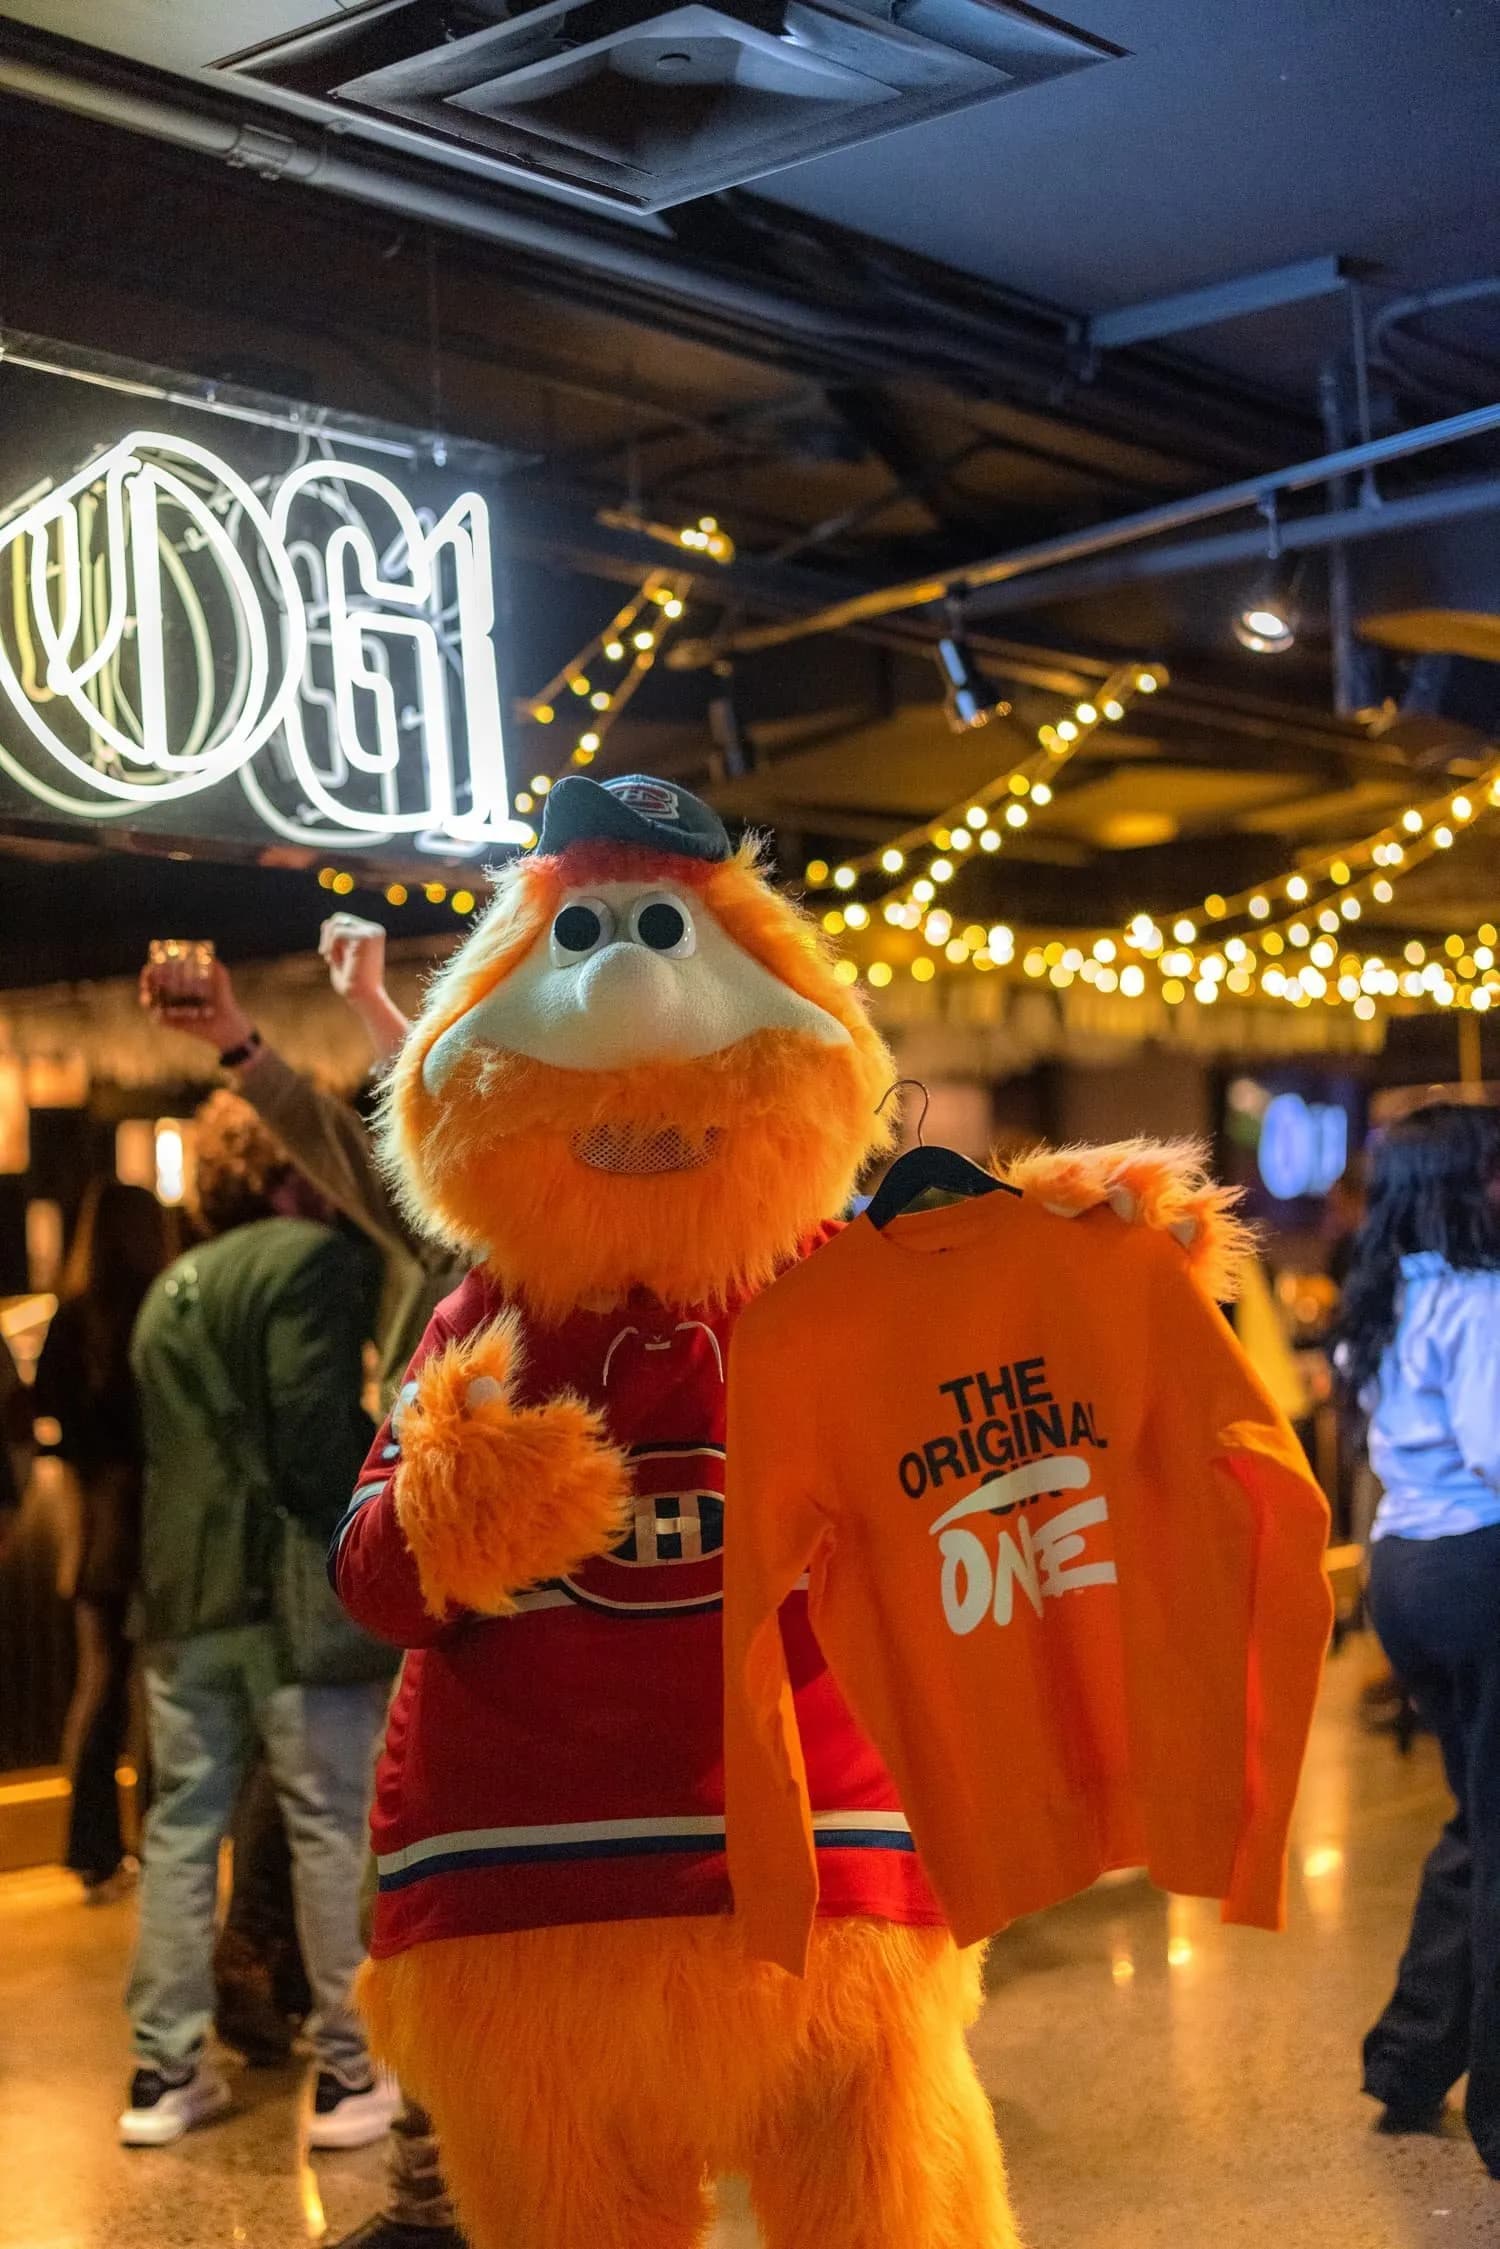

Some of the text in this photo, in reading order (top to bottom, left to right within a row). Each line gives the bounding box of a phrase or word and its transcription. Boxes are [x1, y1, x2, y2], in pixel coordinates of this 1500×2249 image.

[939, 1356, 1053, 1424] THE
[898, 1402, 1108, 1499] ORIGINAL
[938, 1495, 1117, 1635] ONE
